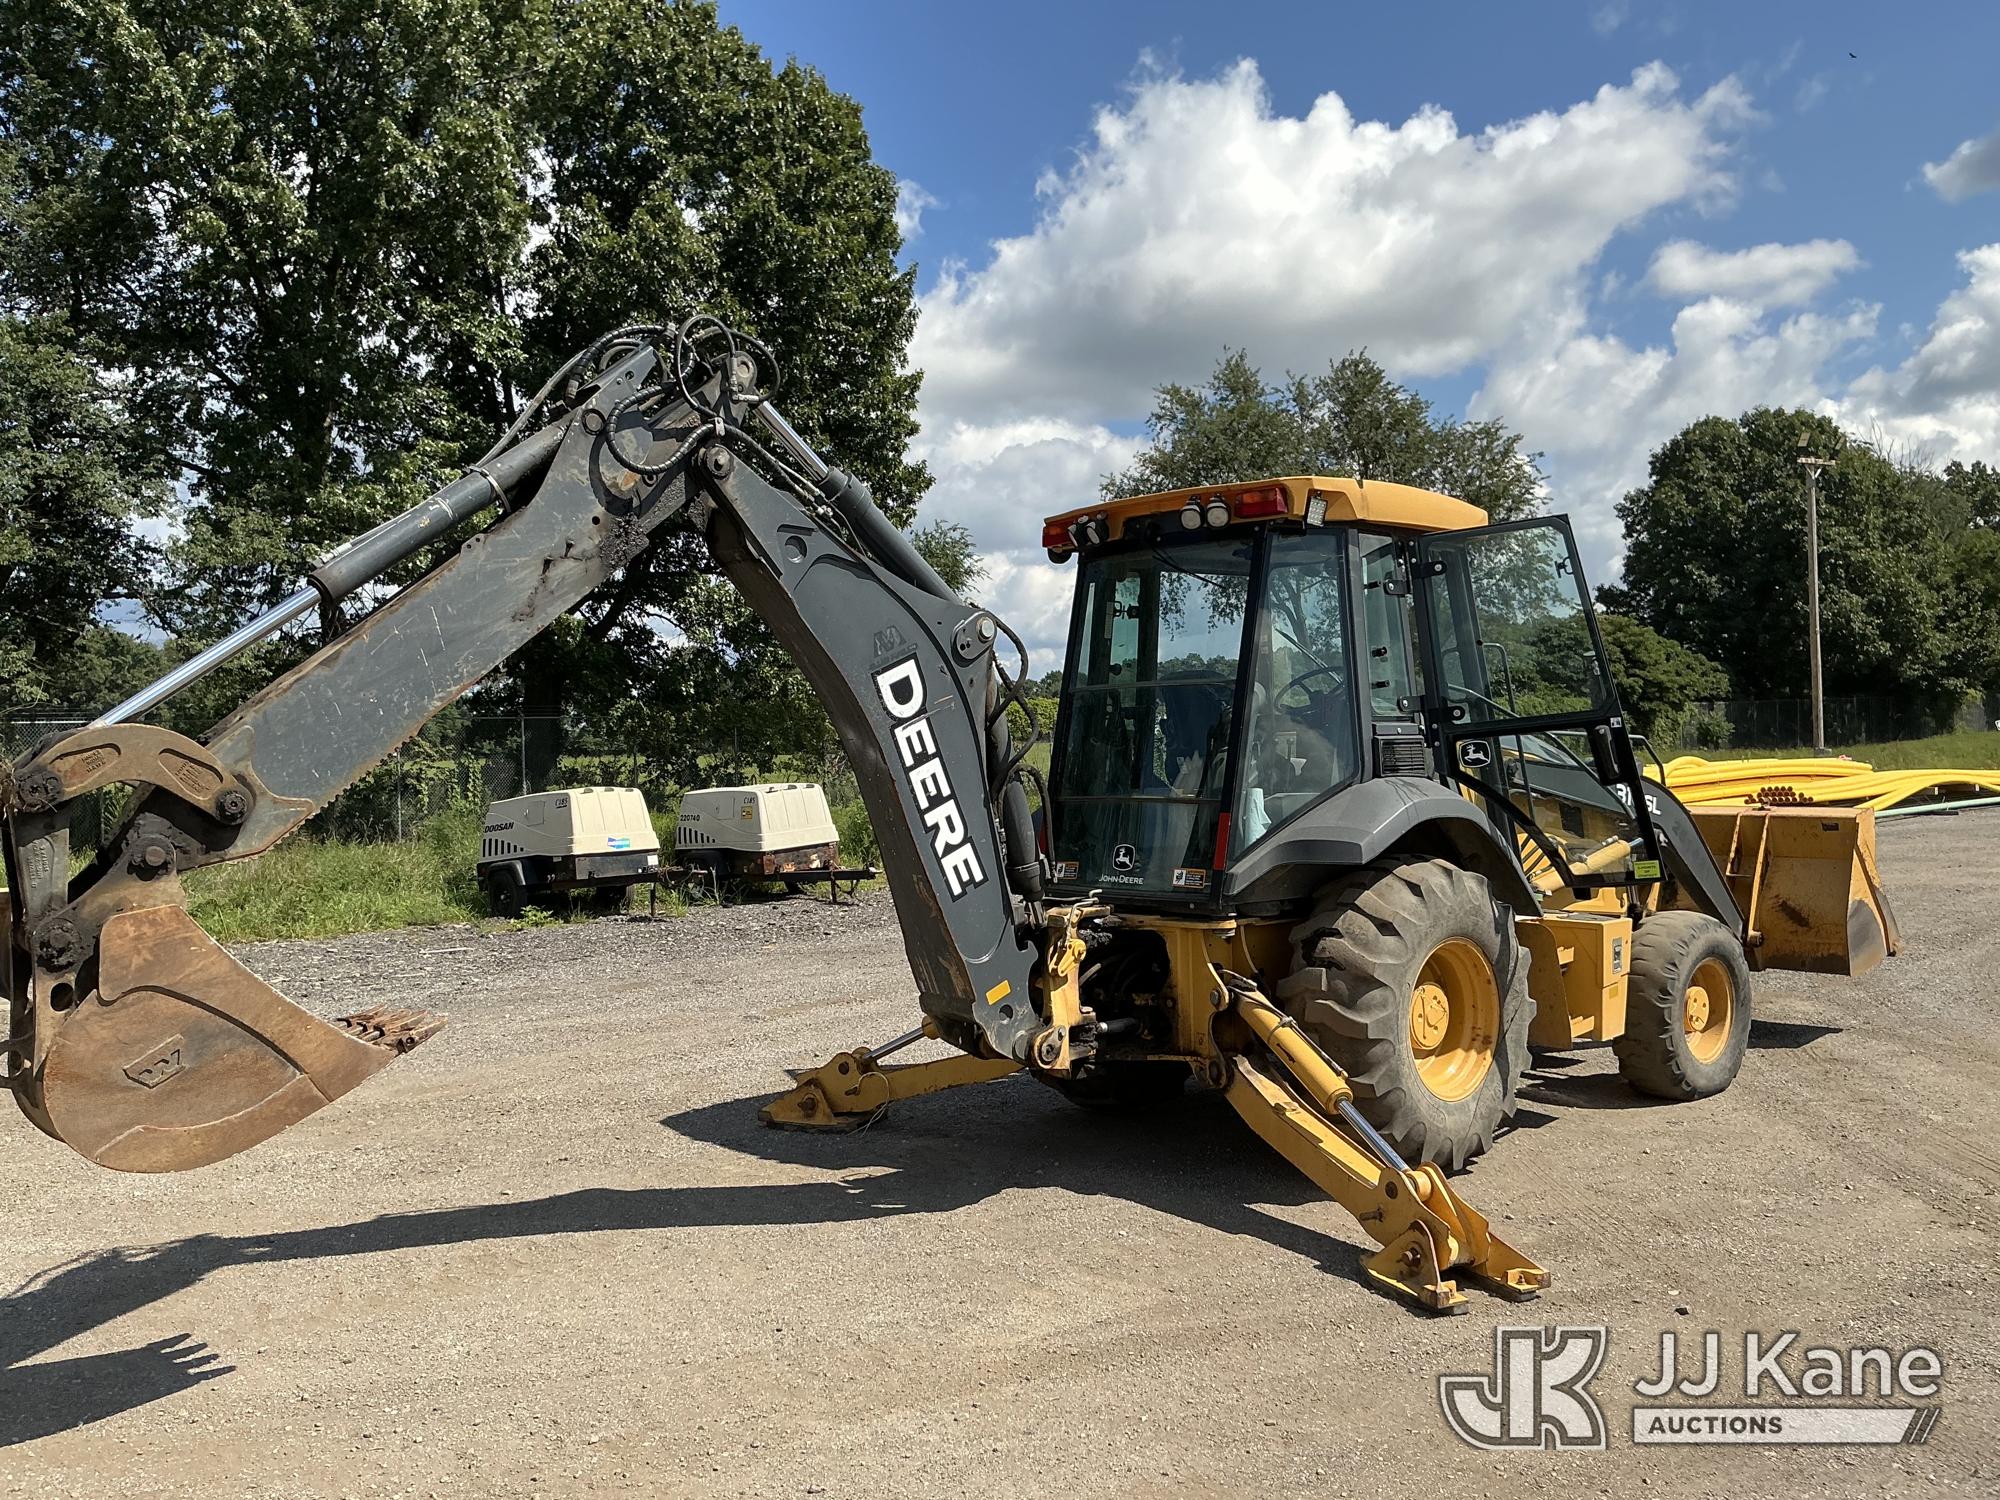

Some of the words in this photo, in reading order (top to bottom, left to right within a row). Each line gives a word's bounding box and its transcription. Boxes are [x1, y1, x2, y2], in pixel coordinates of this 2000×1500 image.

[875, 657, 985, 898] DEERE
[1616, 783, 1661, 815] 31SL
[484, 821, 515, 833] DOOSAN
[1099, 873, 1118, 882] JOHN
[1119, 874, 1144, 885] DEERE
